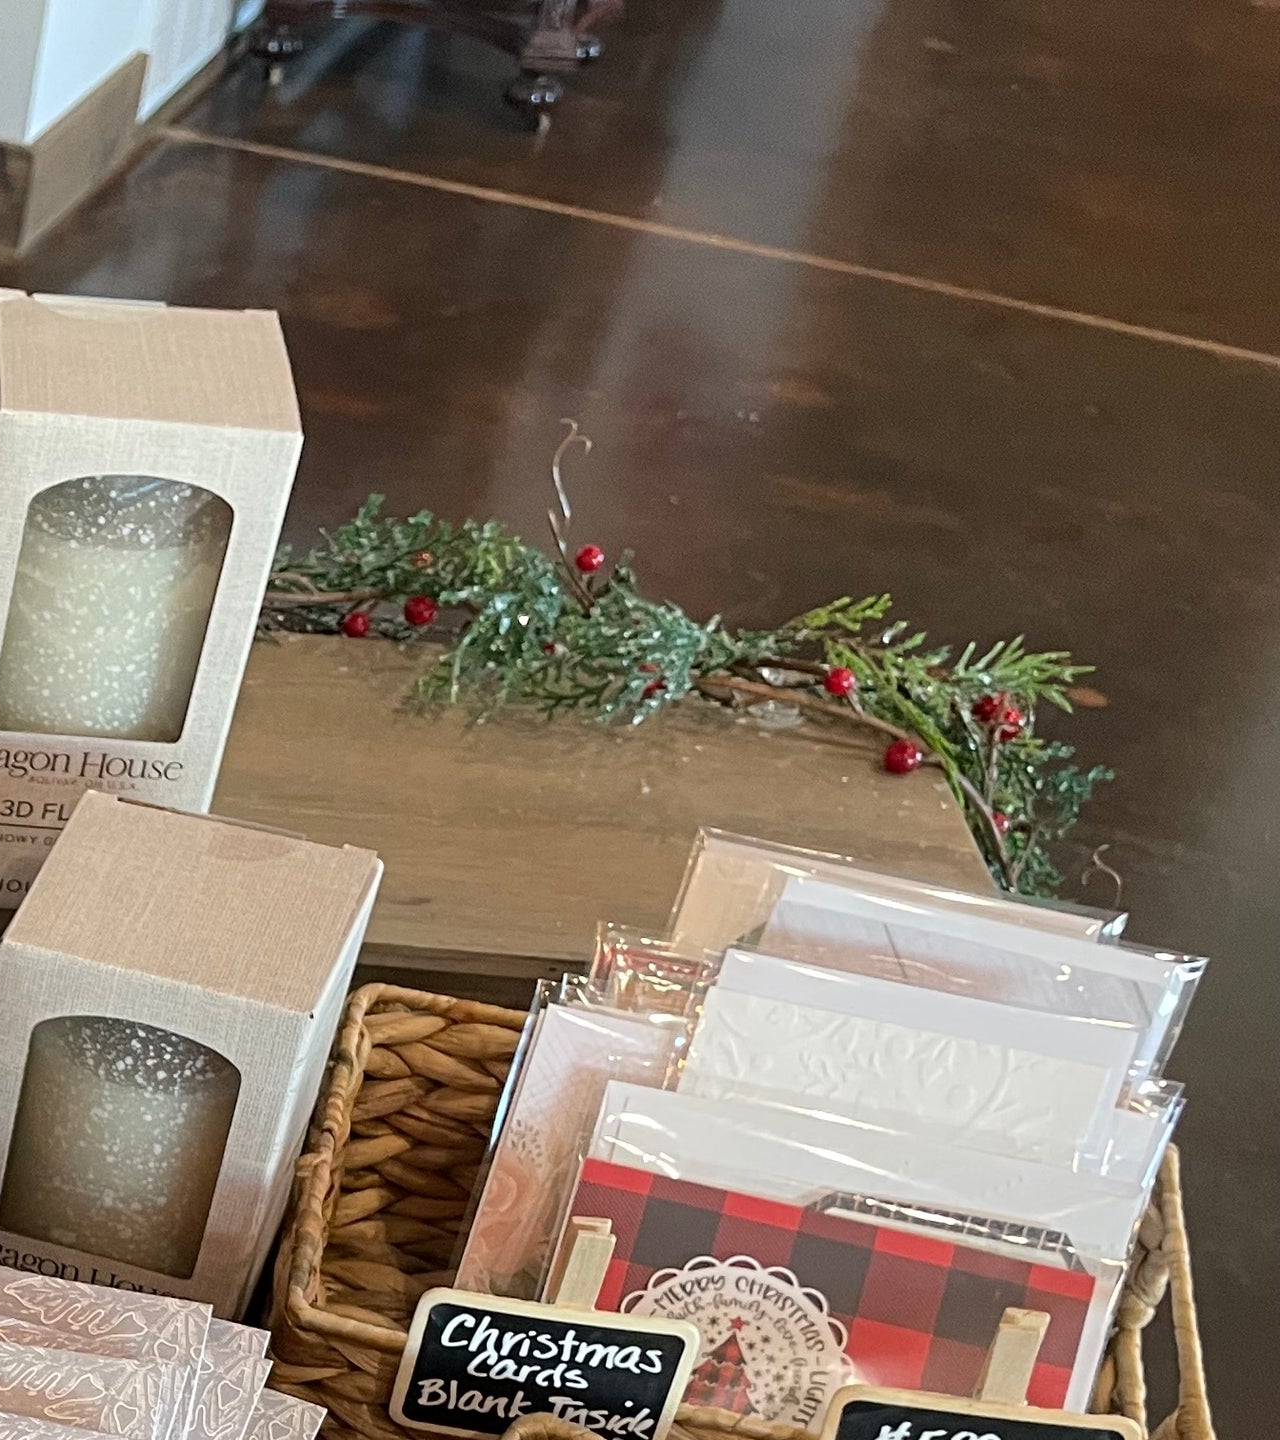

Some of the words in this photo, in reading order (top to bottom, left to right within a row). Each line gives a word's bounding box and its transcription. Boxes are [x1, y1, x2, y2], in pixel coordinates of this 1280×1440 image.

[77, 750, 184, 782] House
[0, 799, 34, 818] 3D
[440, 1312, 663, 1375] Christmas
[466, 1349, 590, 1389] Cards
[417, 1377, 532, 1419] Blank
